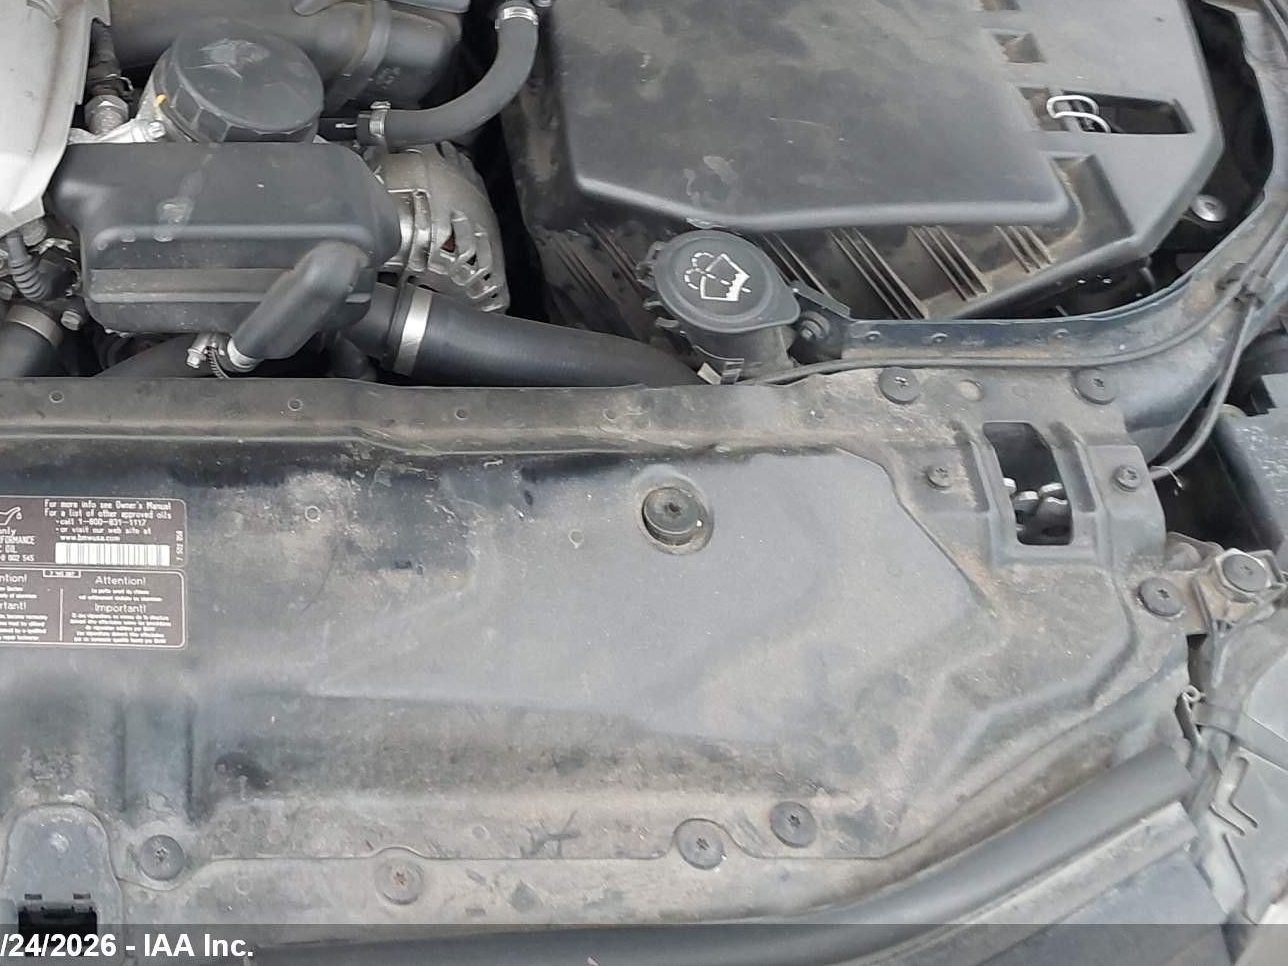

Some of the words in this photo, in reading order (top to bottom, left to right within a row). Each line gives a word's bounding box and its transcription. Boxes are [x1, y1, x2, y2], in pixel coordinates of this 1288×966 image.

[44, 499, 56, 508] For
[81, 500, 96, 508] info
[115, 500, 143, 509] Owner's
[146, 501, 171, 510] Manual
[44, 508, 56, 516] For
[69, 509, 82, 517] list
[86, 509, 94, 517] of
[97, 509, 117, 518] other
[121, 510, 153, 520] approved
[156, 511, 172, 519] oils
[78, 518, 147, 526] 1-800-831-1117
[72, 525, 89, 533] visit
[108, 526, 122, 534] web
[125, 526, 140, 534] site
[143, 527, 151, 535] at
[60, 534, 121, 542] www.bmwusa.com
[5, 544, 17, 553] OIL
[94, 575, 146, 585] Attention!
[94, 603, 147, 613] Important!
